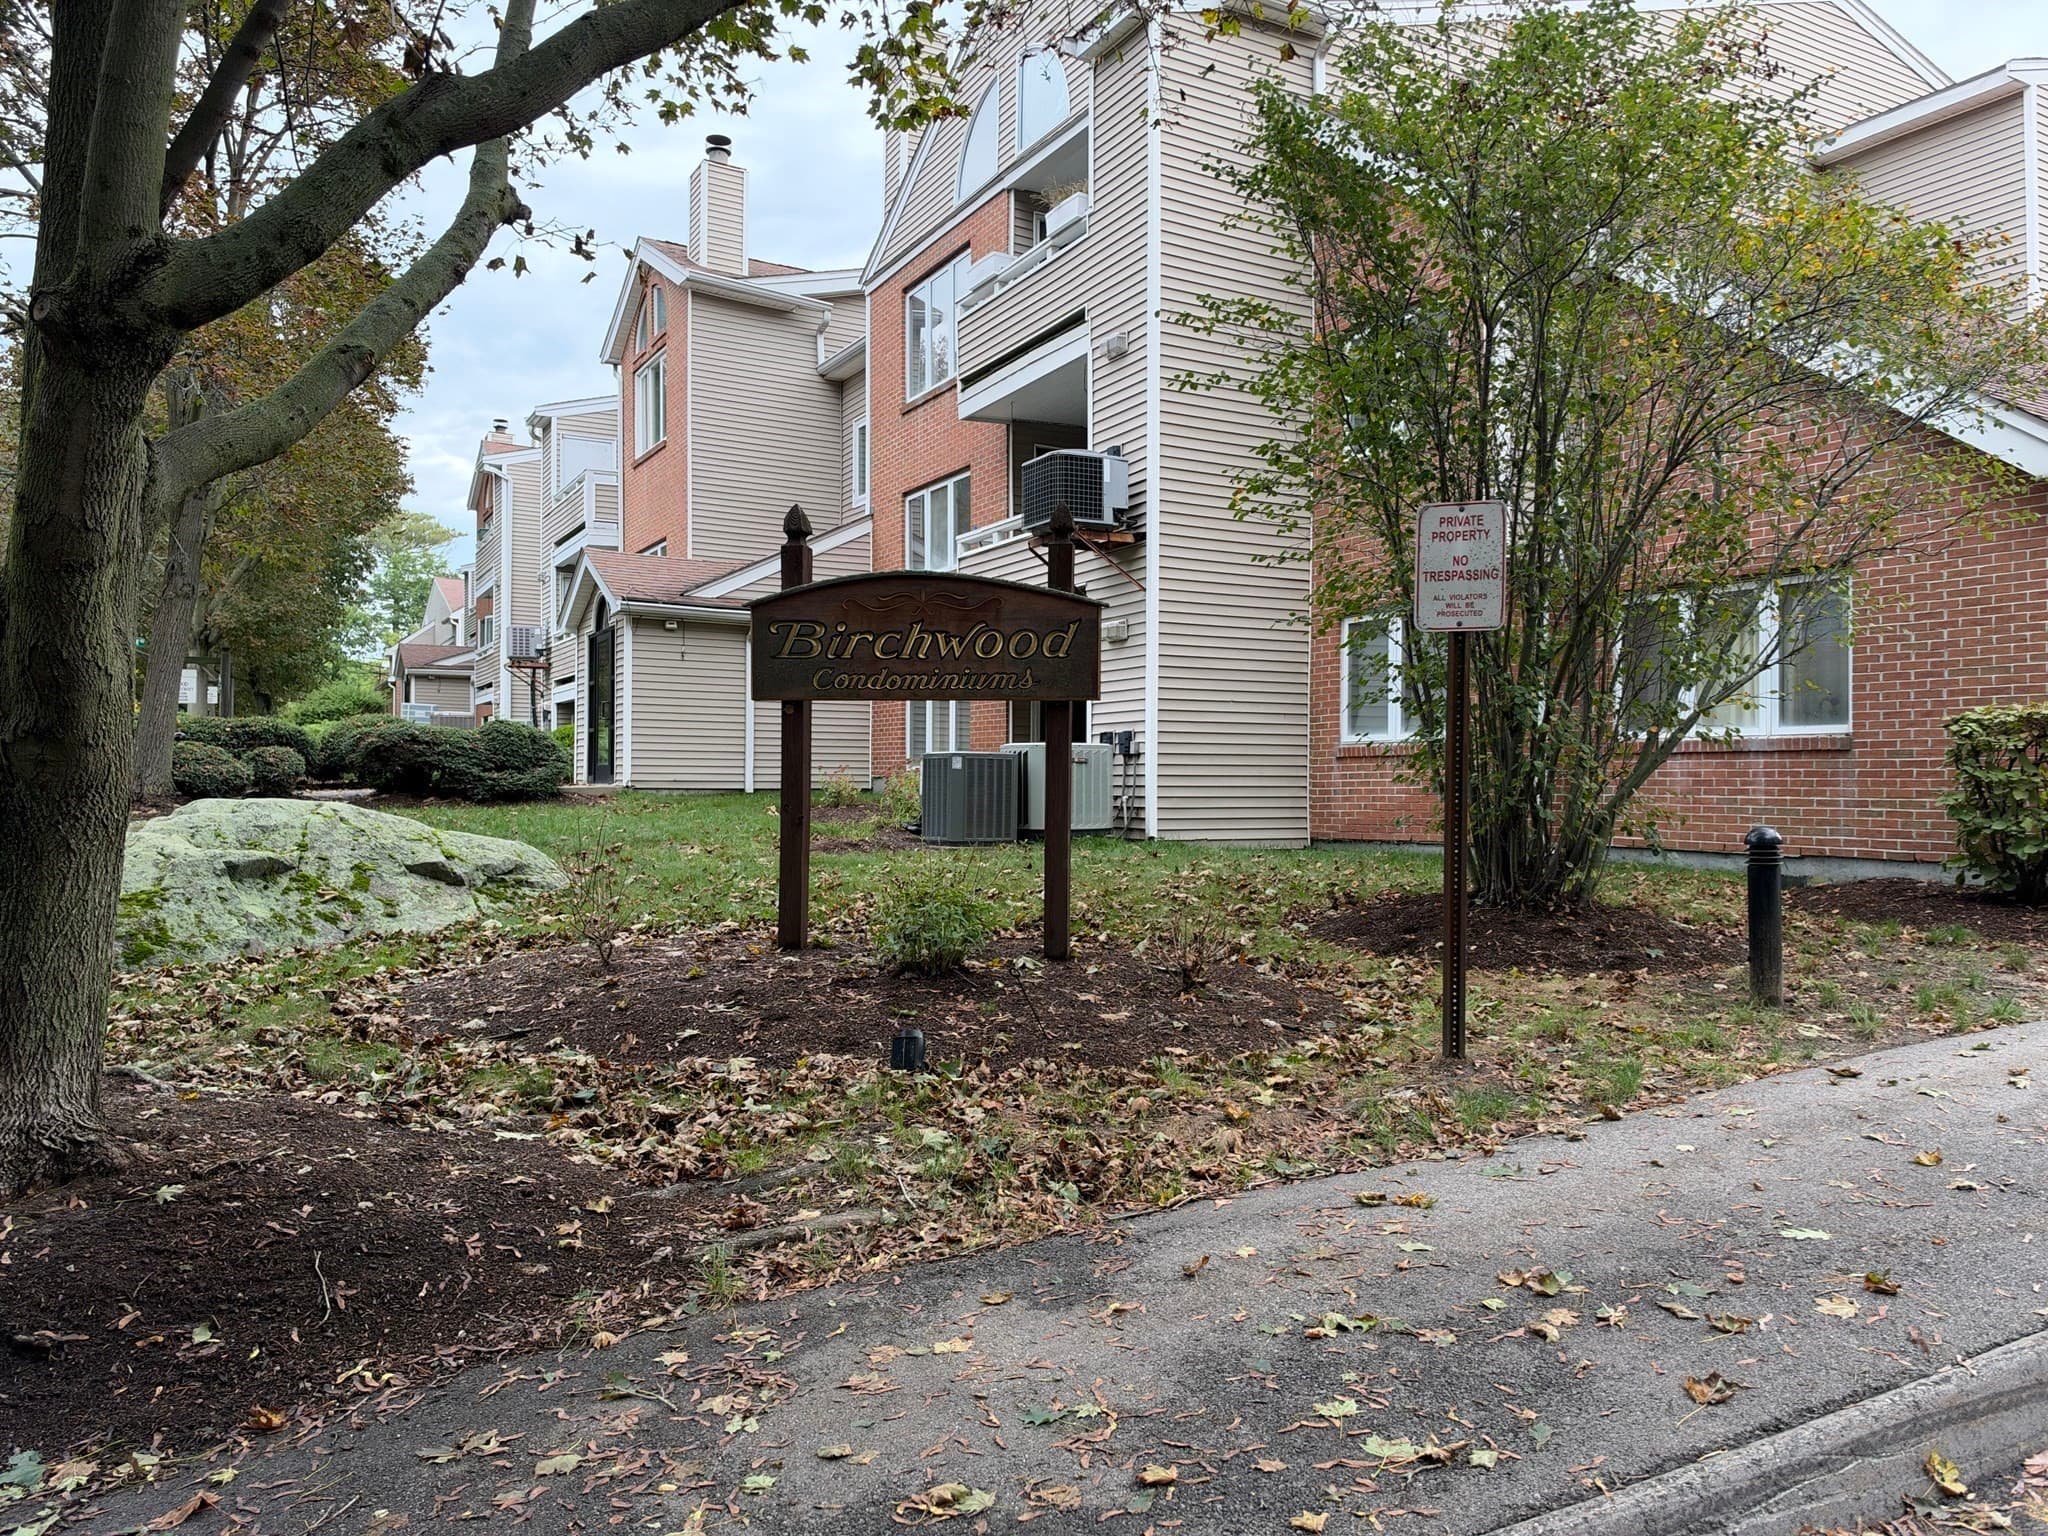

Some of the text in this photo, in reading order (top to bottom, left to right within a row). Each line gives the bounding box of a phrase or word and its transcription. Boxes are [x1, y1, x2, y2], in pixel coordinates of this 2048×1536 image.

[1439, 515, 1484, 527] PRIVATE
[1431, 530, 1490, 542] PROPERTY
[1452, 555, 1468, 566] NO
[1423, 569, 1499, 582] TRESPASSING
[1449, 593, 1488, 601] VIOLATORS
[1464, 601, 1475, 609] BE
[1436, 609, 1483, 617] PROSECUTED
[768, 617, 1083, 661] Birchwood
[812, 667, 1036, 691] Condominiums
